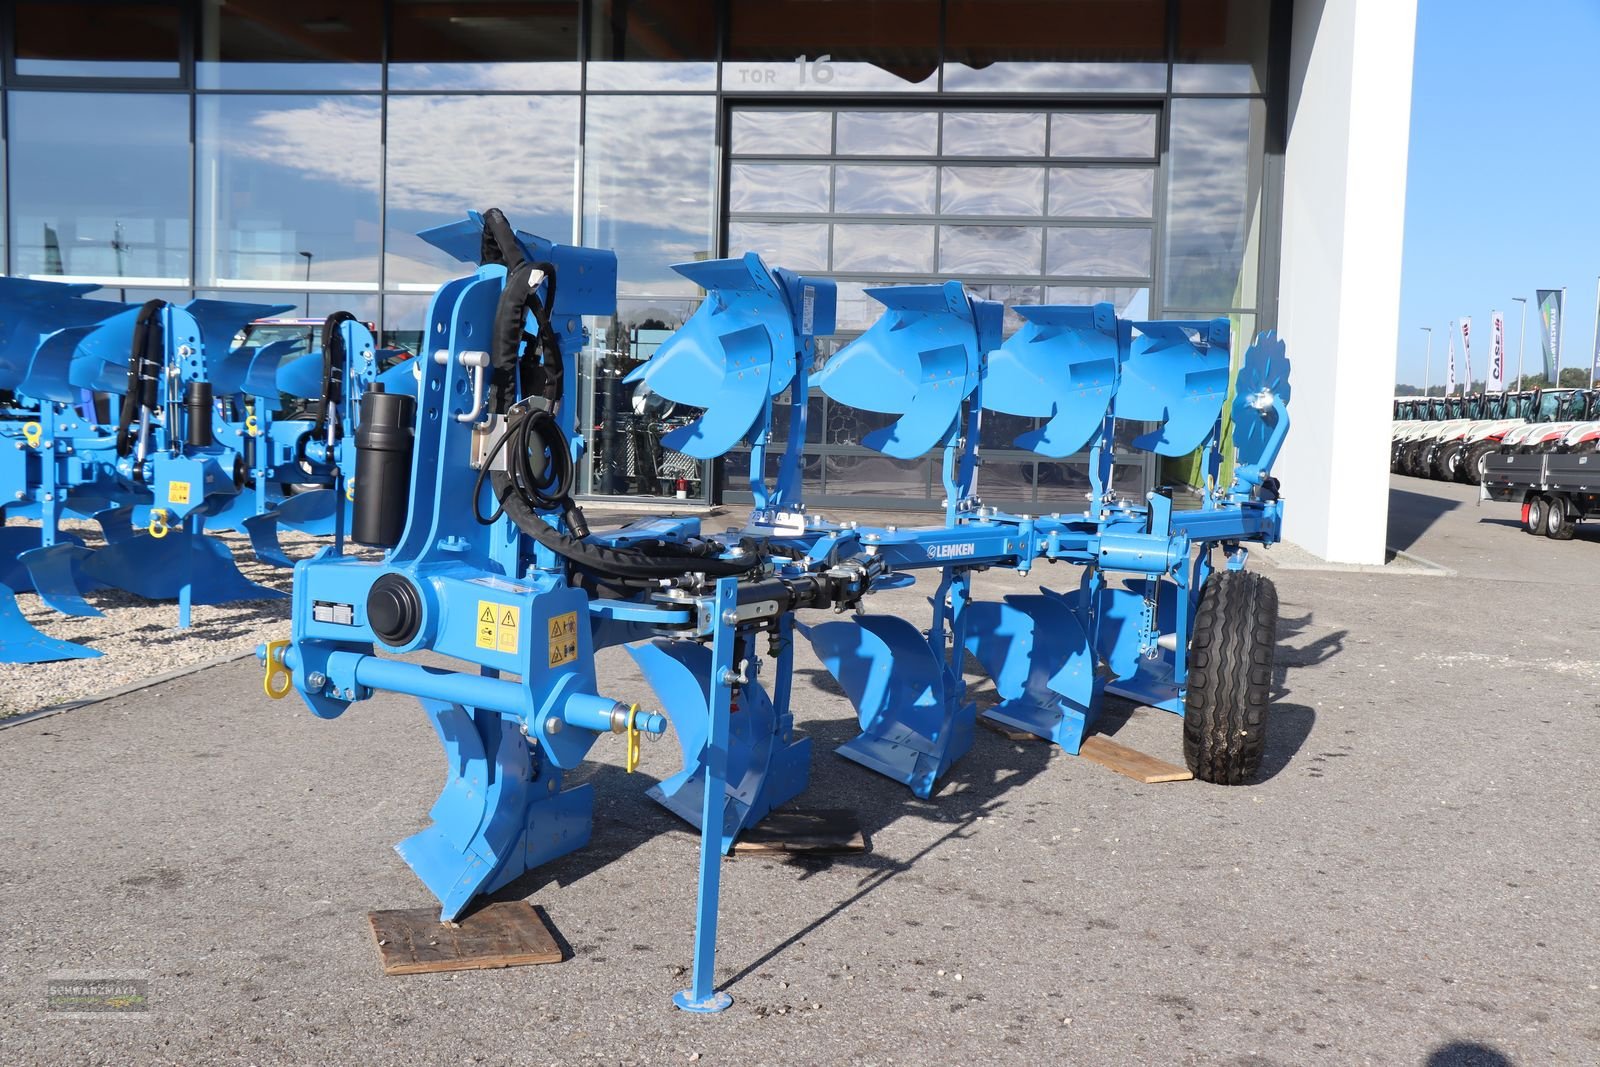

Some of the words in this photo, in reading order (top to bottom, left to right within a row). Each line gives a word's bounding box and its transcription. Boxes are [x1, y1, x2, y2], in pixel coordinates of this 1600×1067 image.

[739, 69, 776, 83] TOR
[795, 54, 834, 84] 16
[936, 543, 975, 558] LEMKEN
